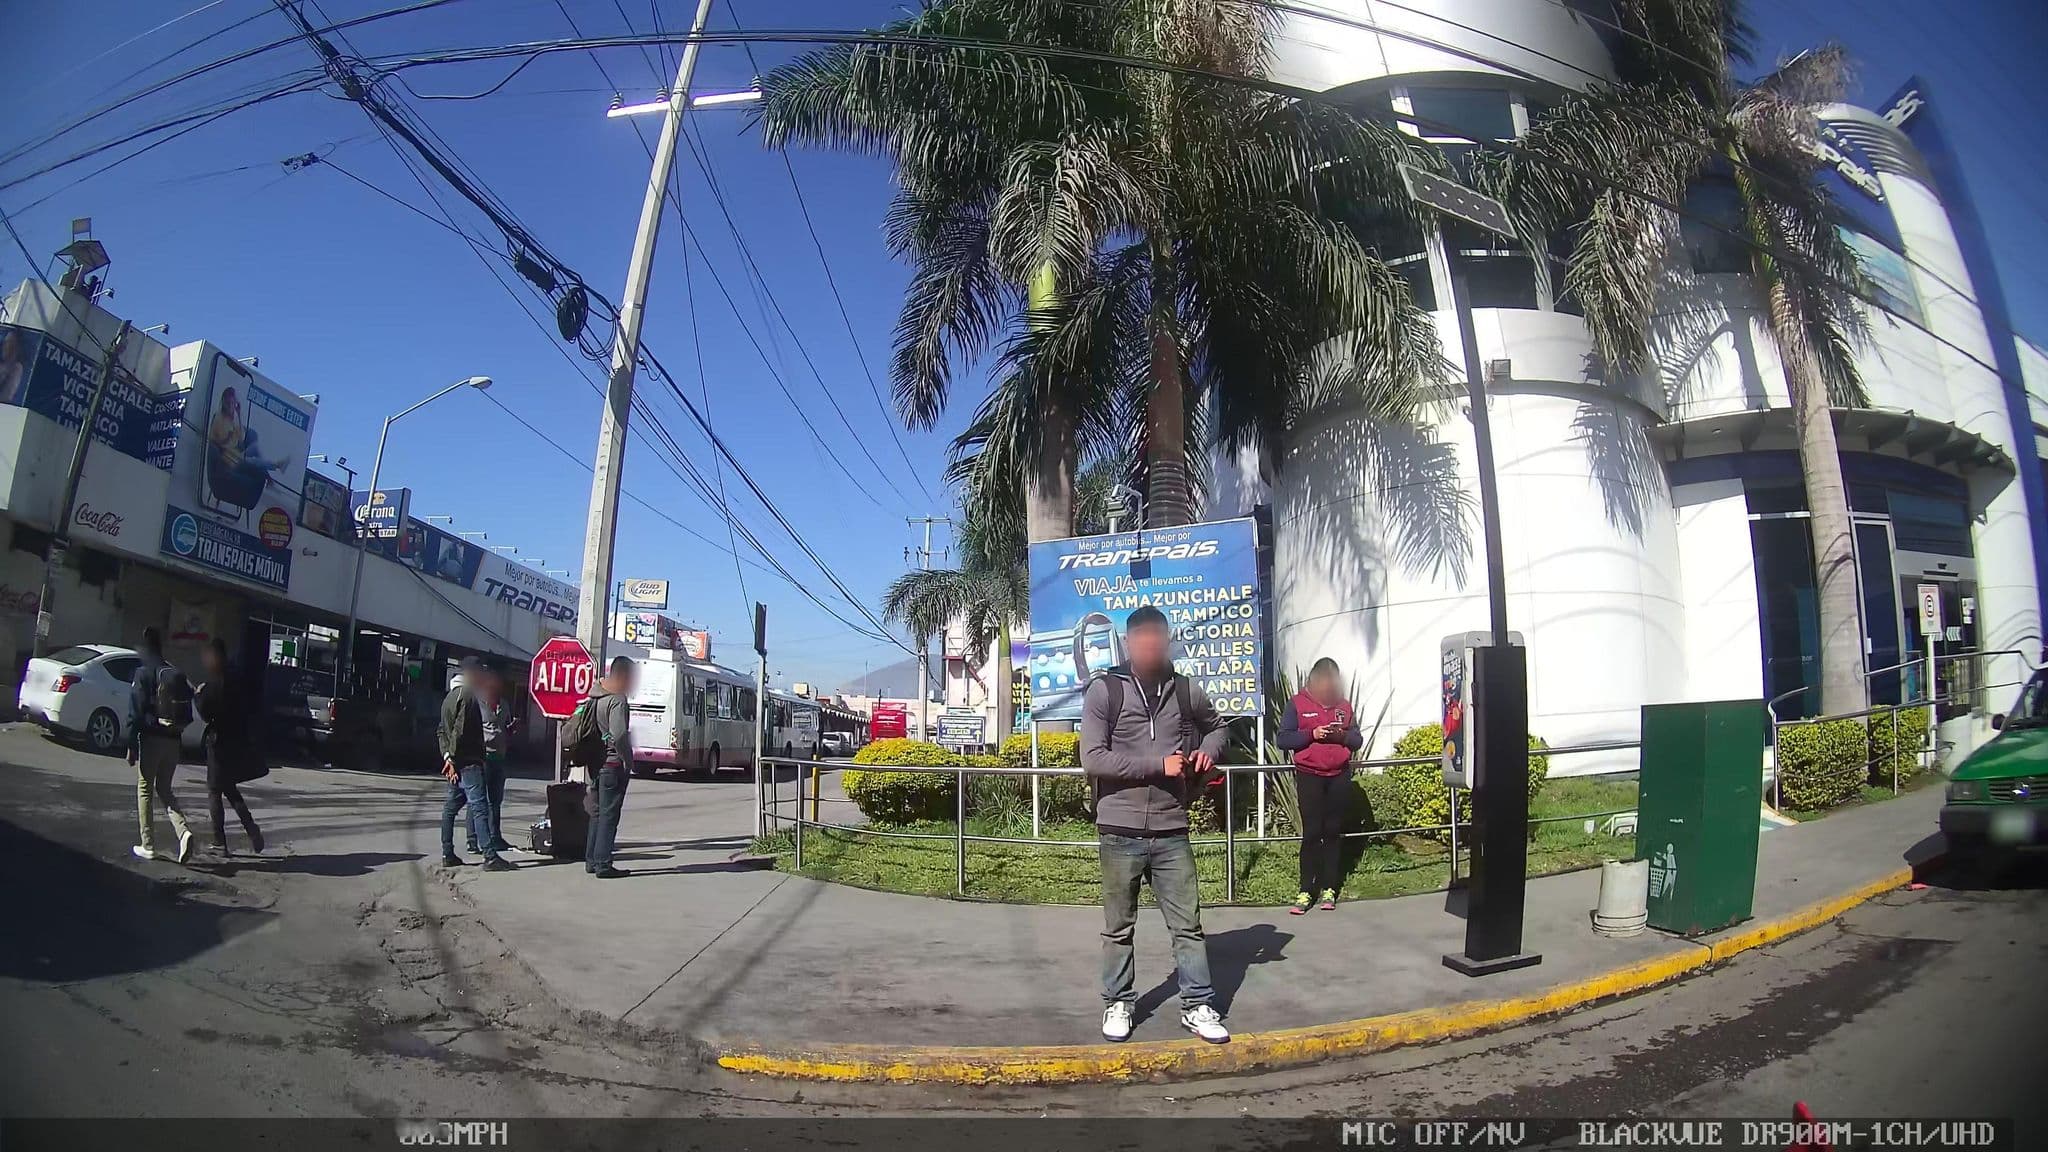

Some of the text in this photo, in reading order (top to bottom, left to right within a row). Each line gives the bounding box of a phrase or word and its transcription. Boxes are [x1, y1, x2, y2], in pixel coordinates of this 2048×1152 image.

[45, 342, 153, 414] TAMAZUCHALE
[63, 374, 125, 421] VICTRIA
[60, 395, 119, 437] TAMICO
[147, 437, 177, 453] VALLES
[1079, 541, 1099, 551] Mejor
[1101, 540, 1114, 549] por
[1153, 533, 1176, 544] Mejor
[1177, 531, 1192, 541] por
[639, 582, 660, 590] BUD
[1074, 574, 1203, 597] VIAJA te llevamos a
[1103, 585, 1252, 611] TAMAZUNCHALE
[1169, 604, 1253, 624] TAMPICO
[1183, 641, 1254, 659] VALLES
[534, 661, 590, 695] ALTO
